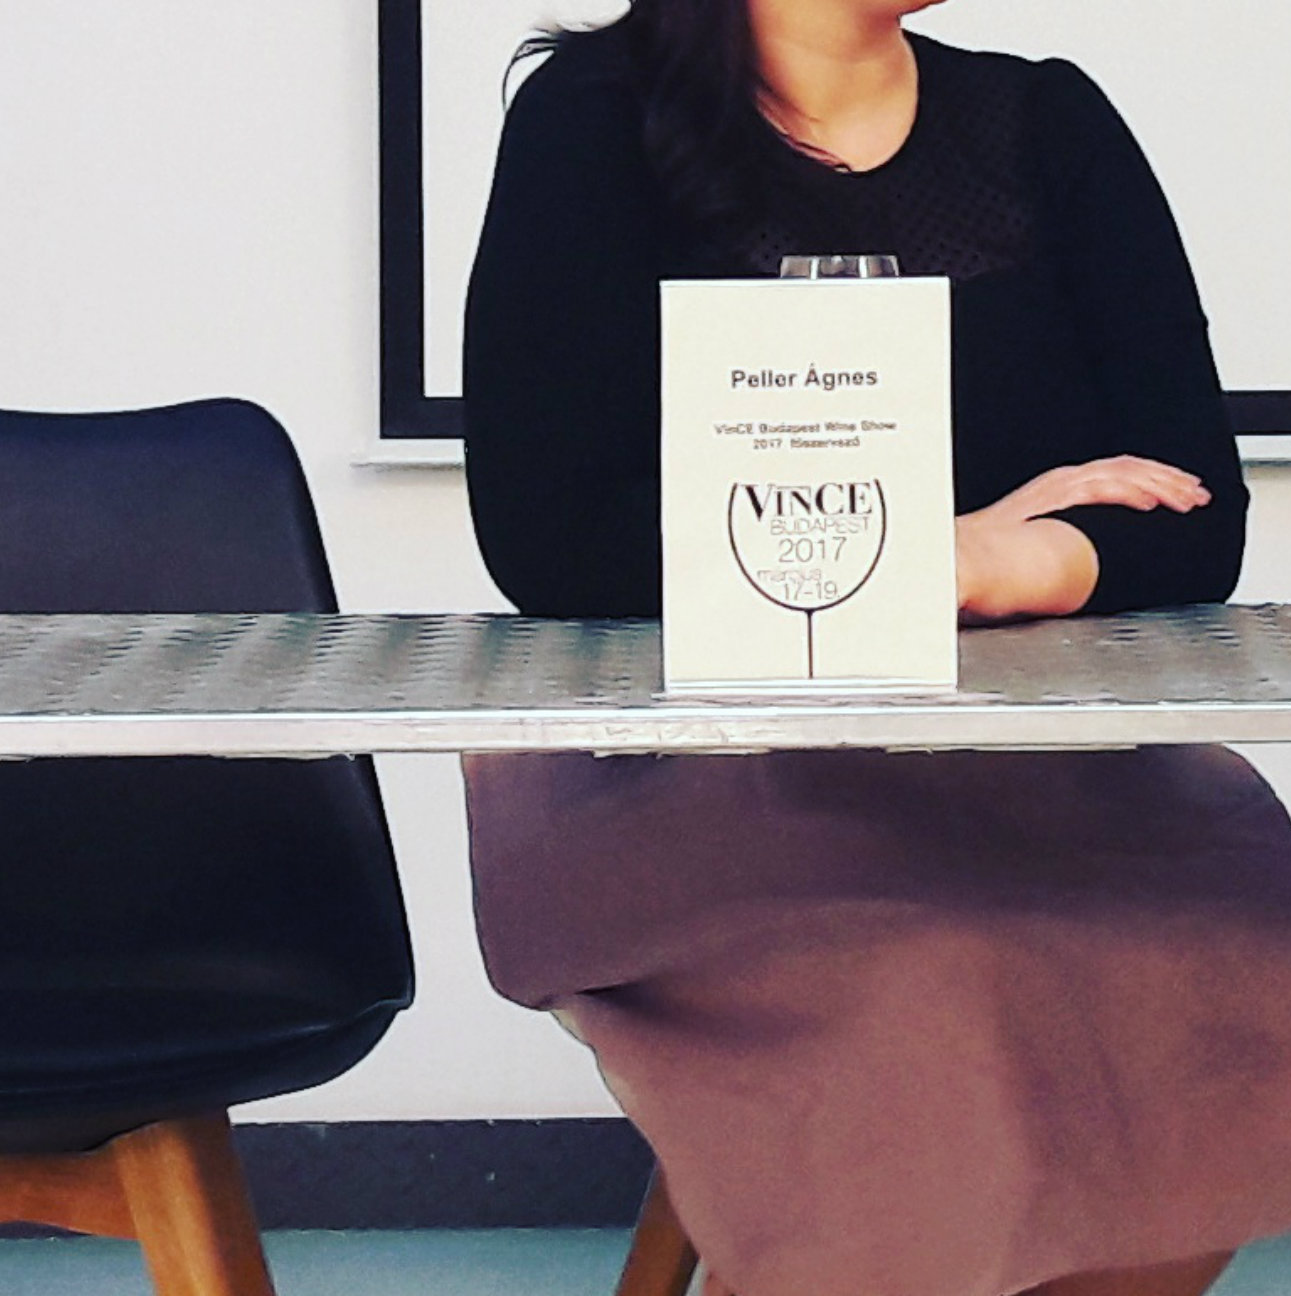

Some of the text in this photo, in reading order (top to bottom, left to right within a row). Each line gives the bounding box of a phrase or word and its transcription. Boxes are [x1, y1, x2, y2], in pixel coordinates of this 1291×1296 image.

[731, 362, 878, 391] Peller Ágnes
[770, 516, 870, 535] BUDAPEST
[778, 536, 847, 563] 2017
